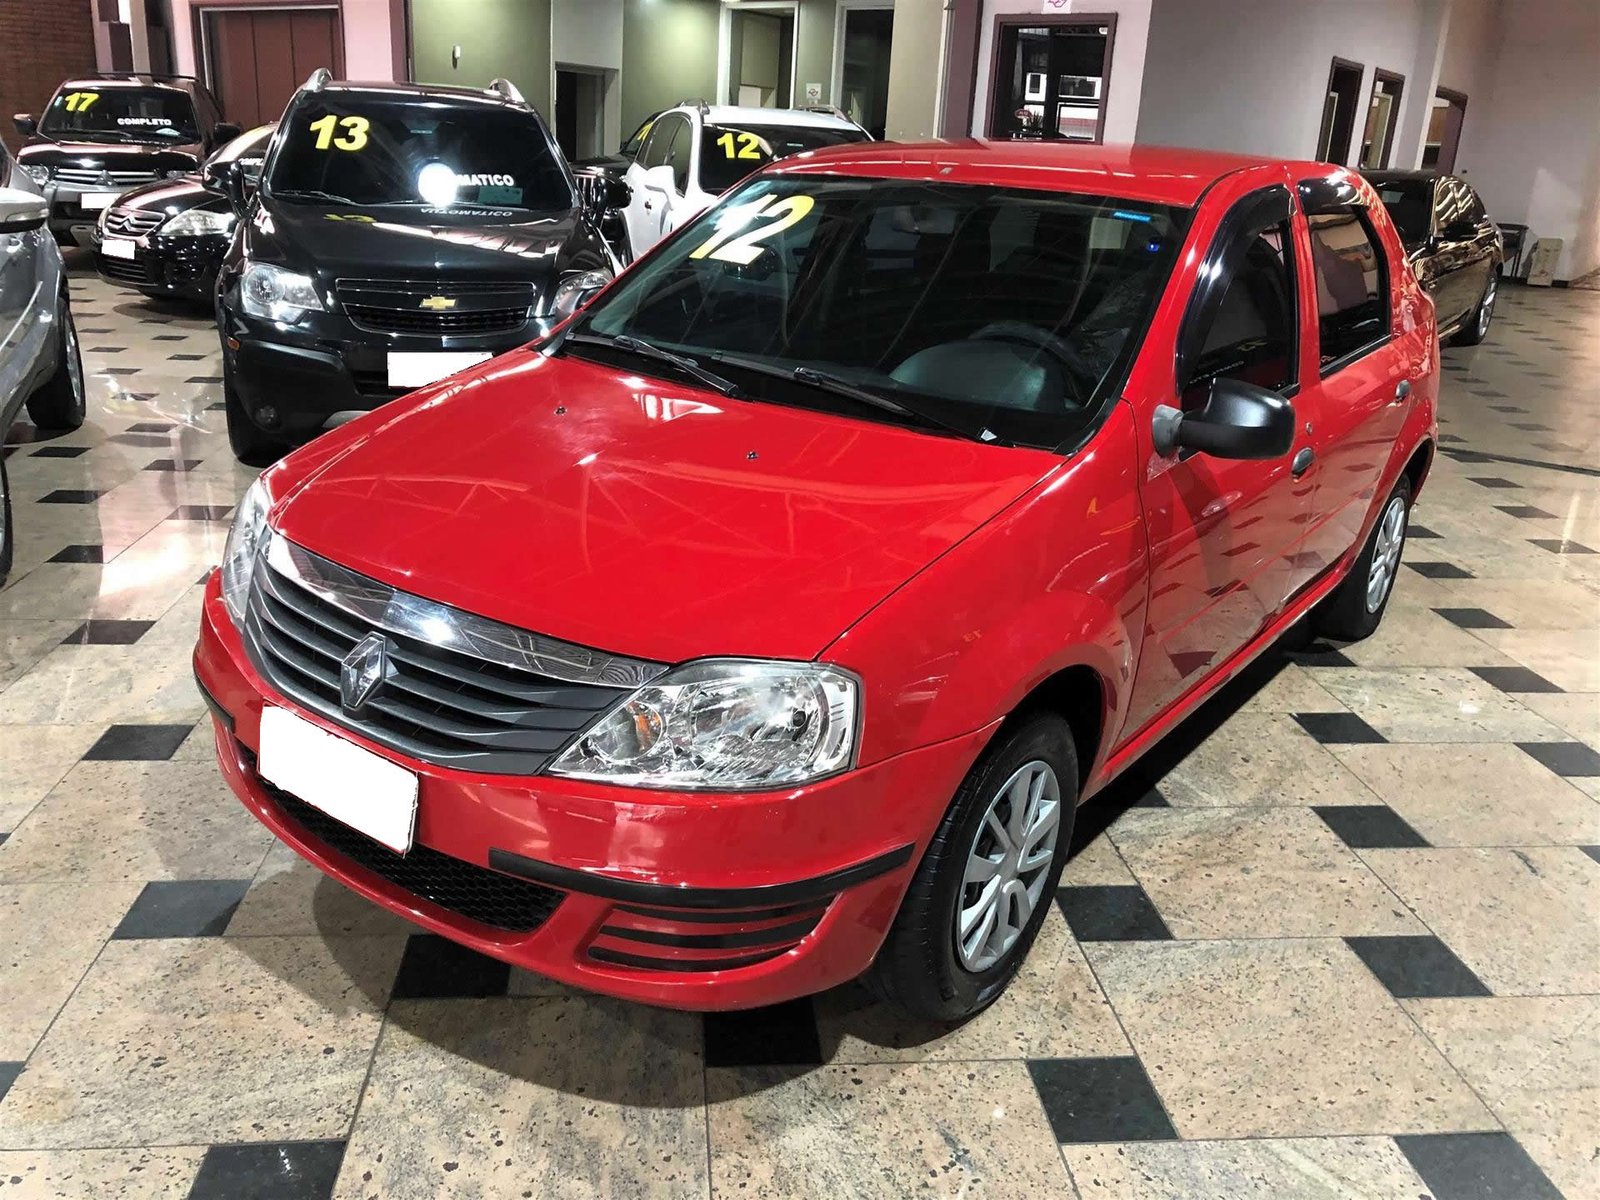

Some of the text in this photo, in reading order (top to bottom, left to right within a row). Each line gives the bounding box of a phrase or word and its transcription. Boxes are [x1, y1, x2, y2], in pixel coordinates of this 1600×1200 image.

[65, 92, 99, 112] 17
[116, 117, 172, 126] COMPLETO
[309, 114, 370, 151] 13
[716, 132, 761, 159] 12
[455, 174, 515, 187] MATICO
[688, 192, 815, 265] 12
